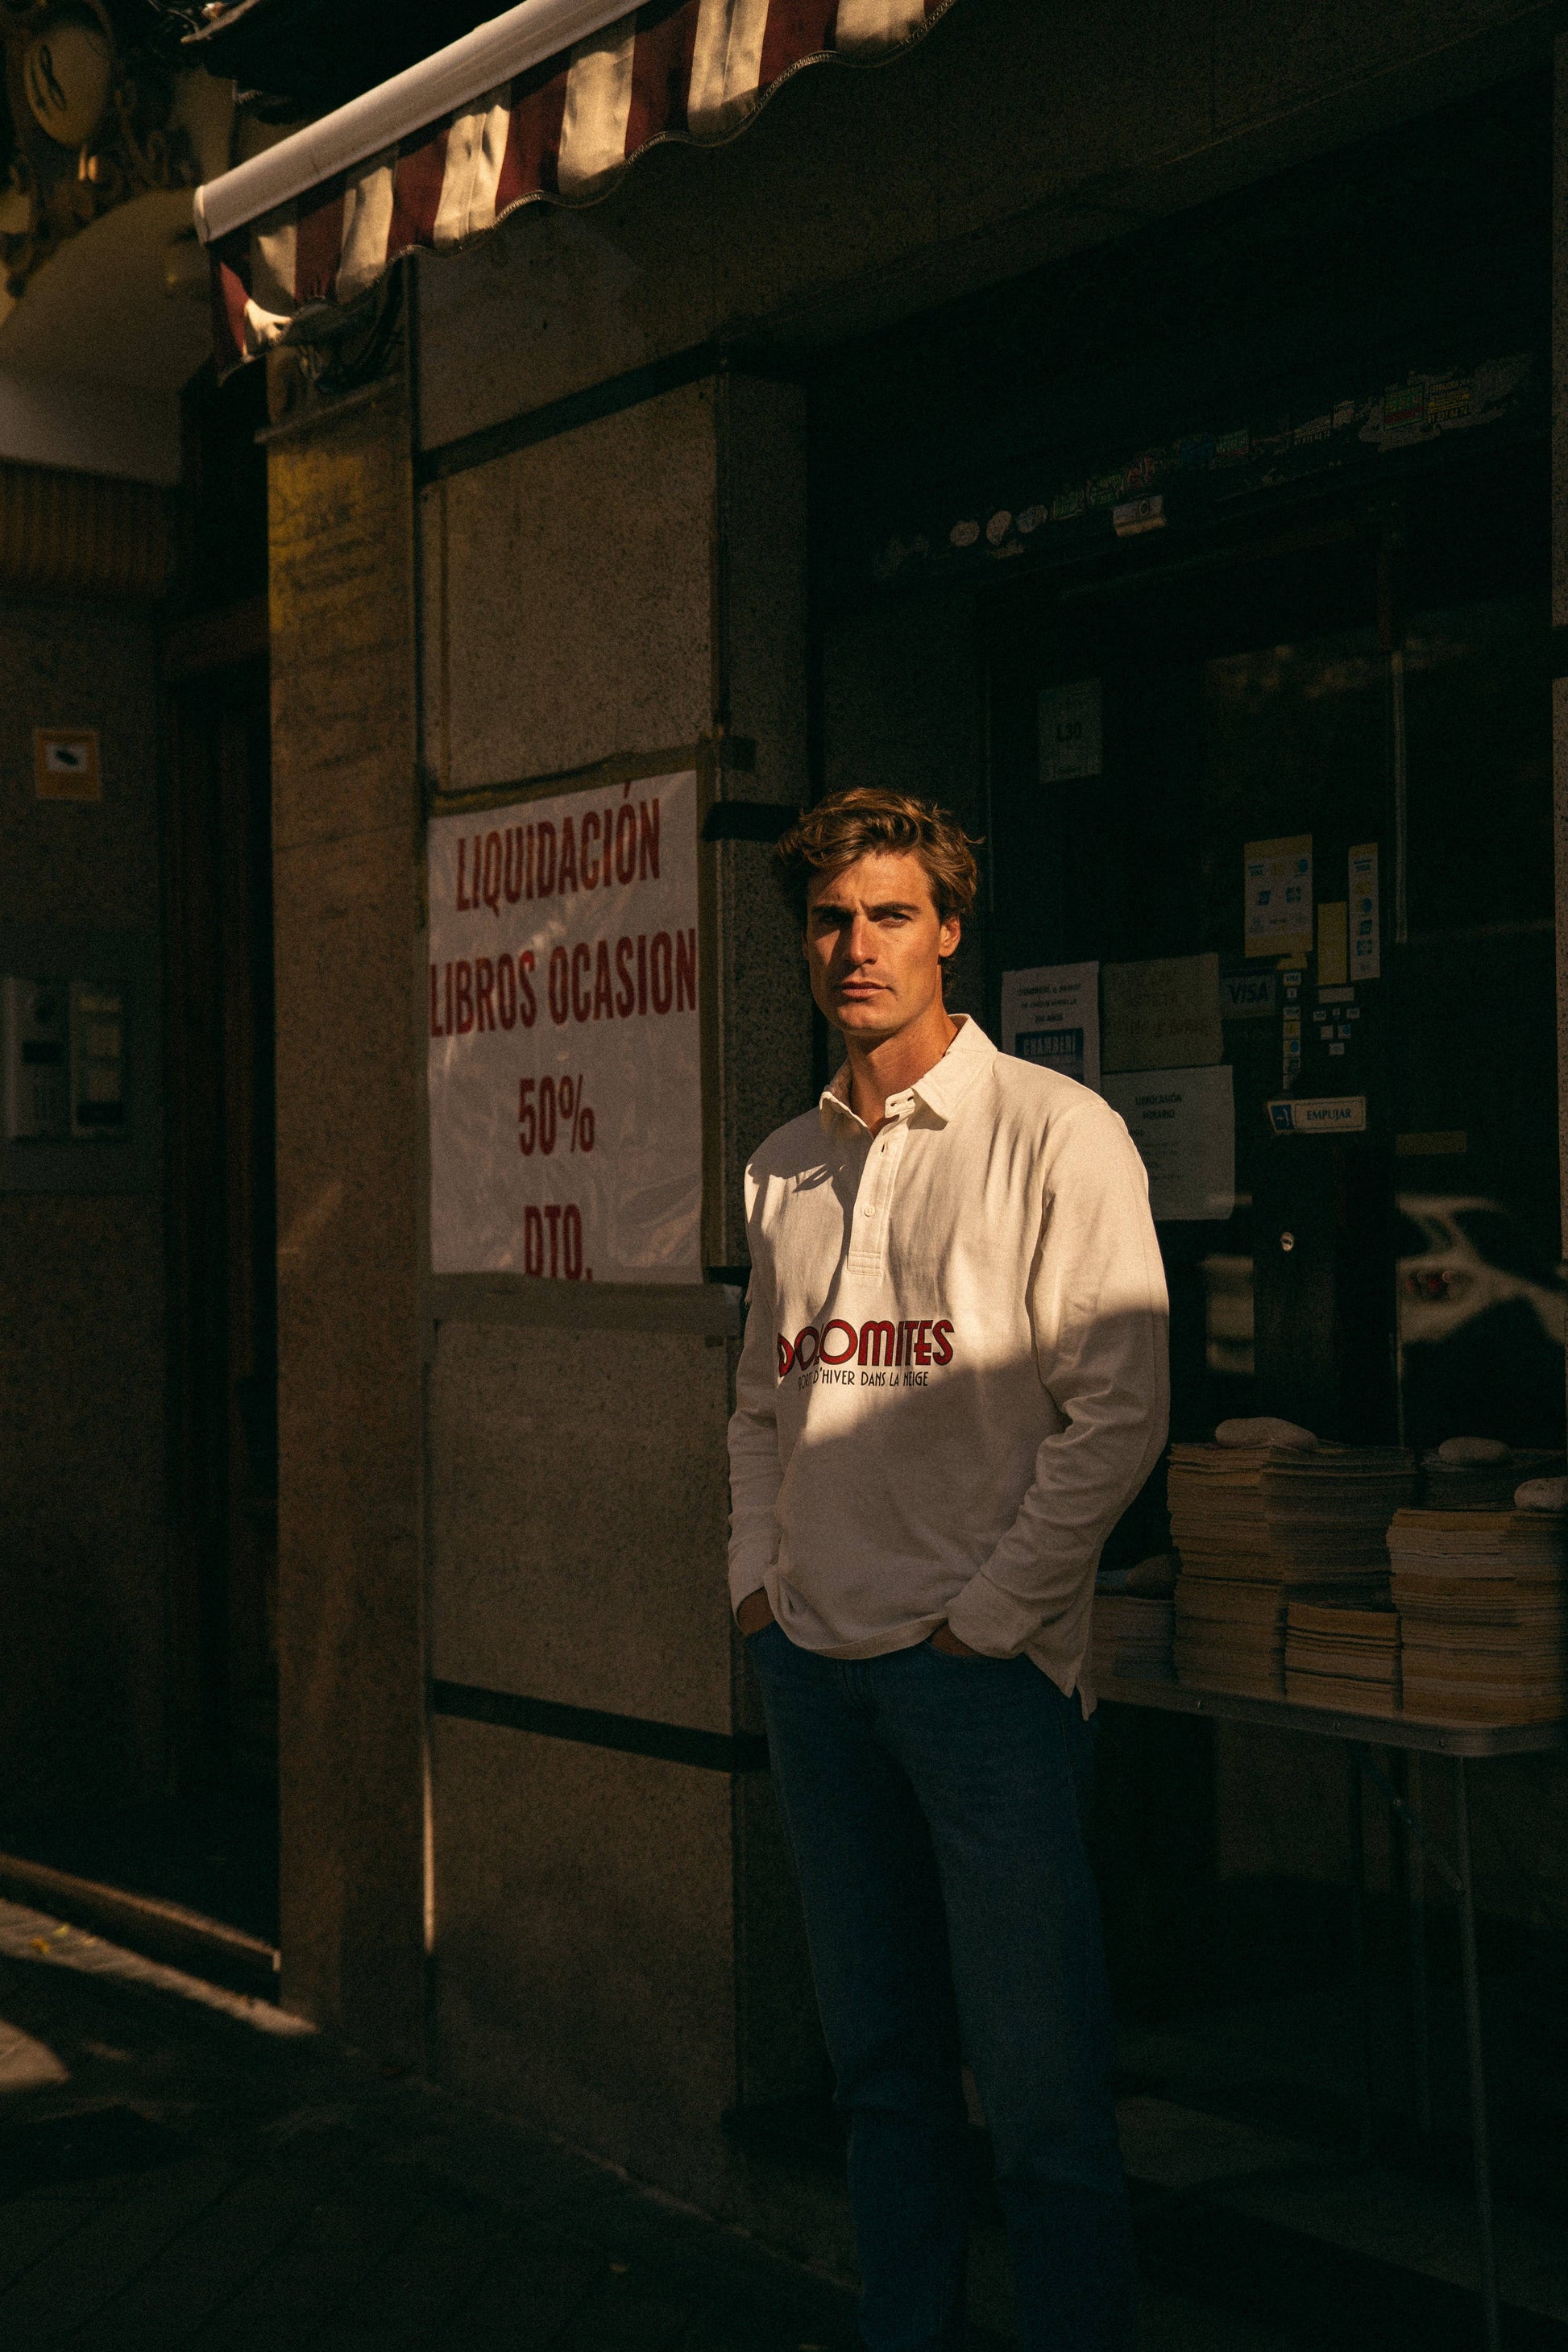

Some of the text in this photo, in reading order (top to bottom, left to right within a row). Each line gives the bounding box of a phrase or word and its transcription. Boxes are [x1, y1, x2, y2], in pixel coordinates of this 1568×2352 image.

[457, 780, 661, 917] LIQUIDACIÓN
[429, 928, 697, 1038] LIBROS OCASION
[1226, 981, 1268, 1004] VISA
[518, 1074, 595, 1155] 50%
[1306, 1108, 1351, 1122] EMPUJAR
[525, 1204, 593, 1283] DTO.
[861, 1371, 886, 1387] DANS
[889, 1372, 899, 1387] LA
[902, 1371, 928, 1387] NEIGE
